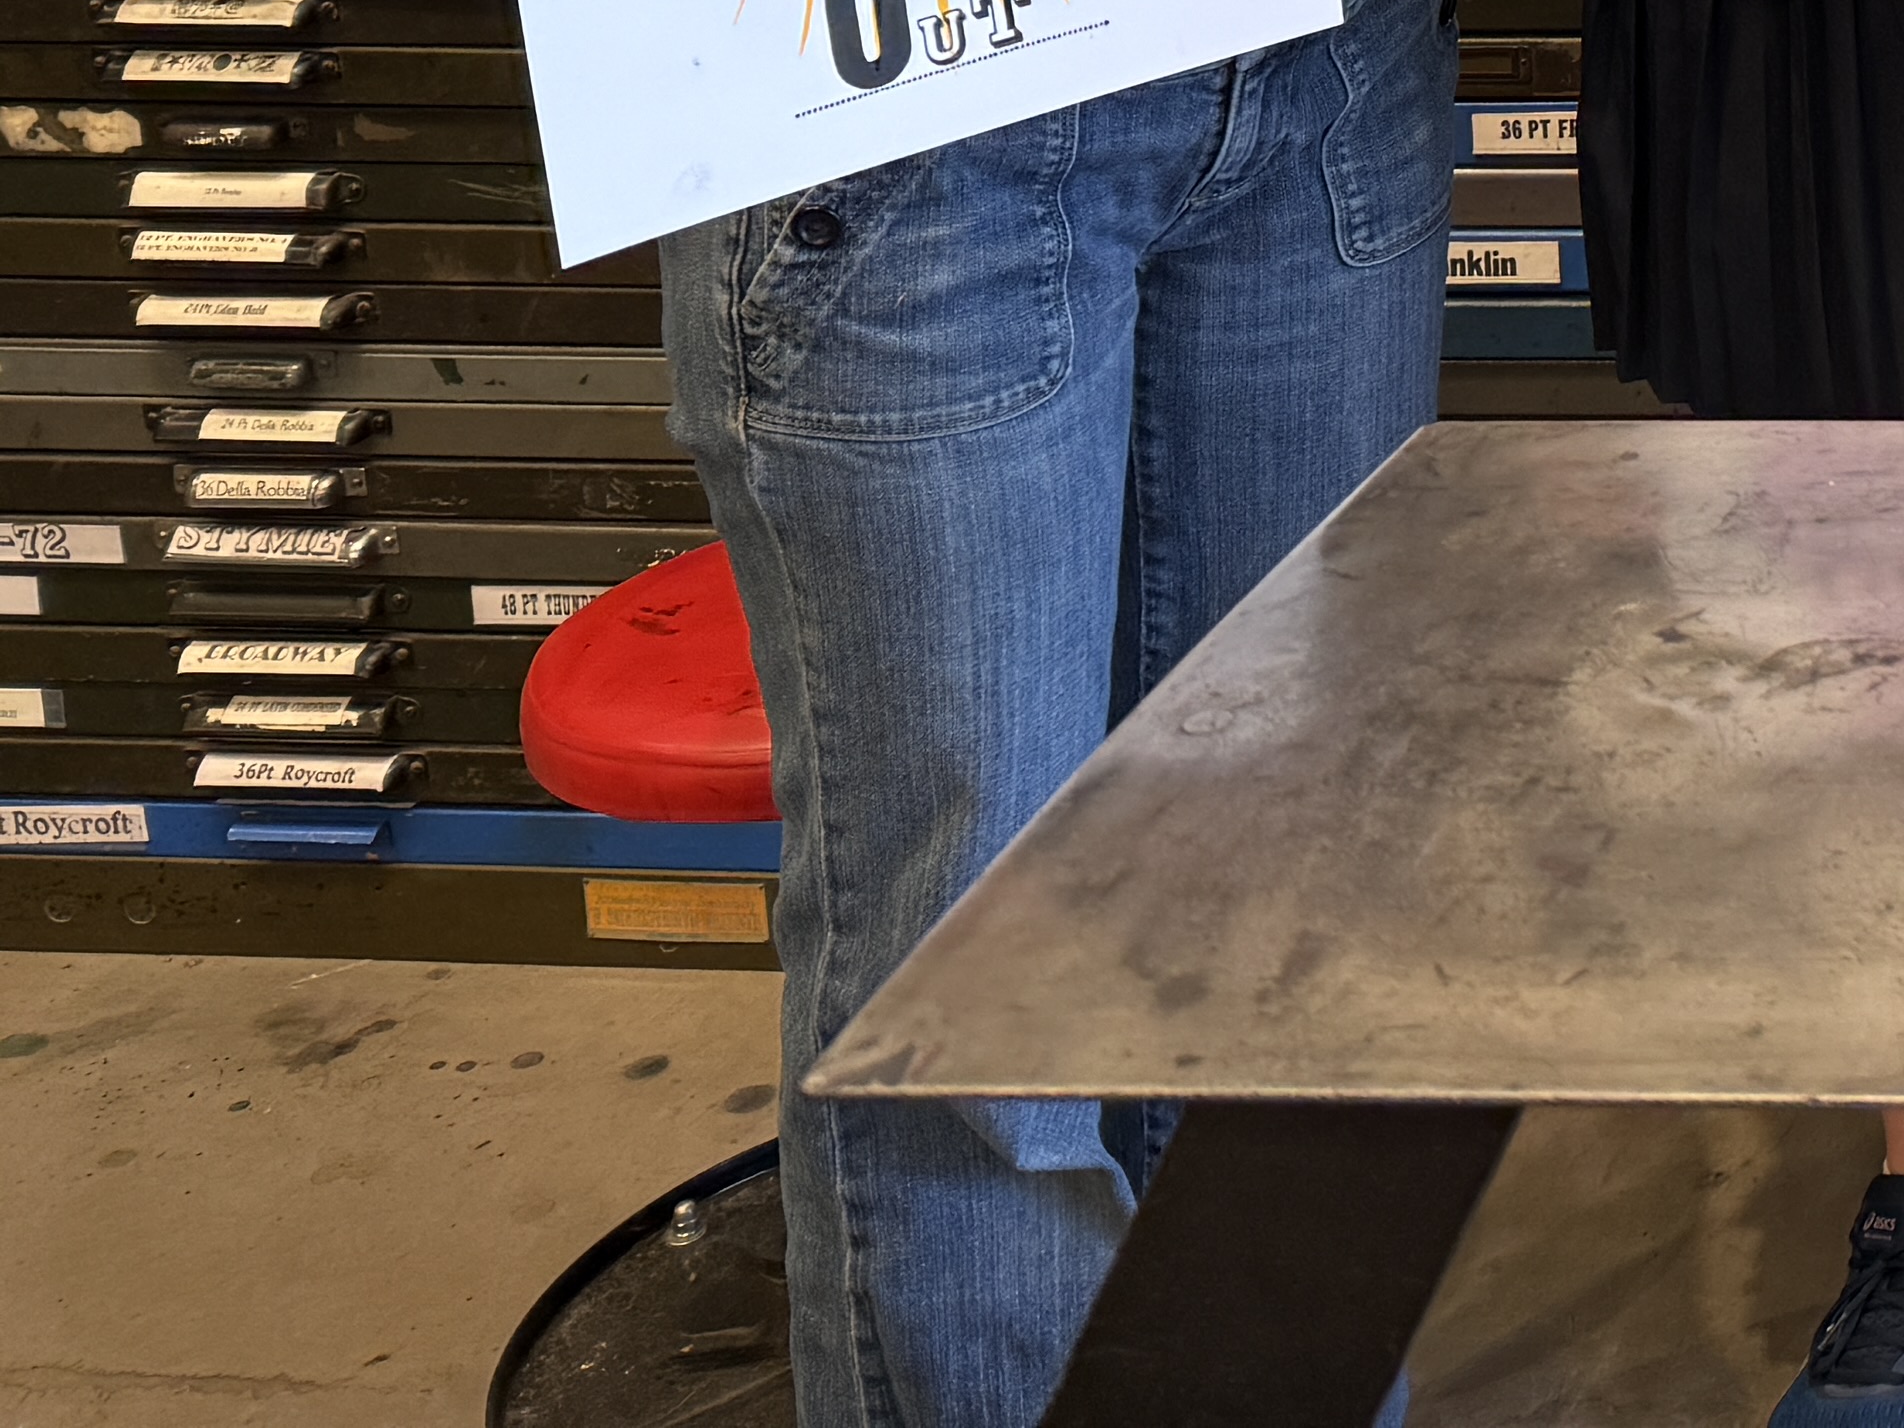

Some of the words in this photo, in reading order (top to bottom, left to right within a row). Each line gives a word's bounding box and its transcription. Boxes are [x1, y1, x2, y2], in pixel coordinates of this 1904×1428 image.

[1501, 120, 1522, 139] 36
[1528, 119, 1551, 138] PT
[502, 594, 517, 615] 48
[521, 594, 538, 615] PT
[234, 762, 274, 781] 36Pt
[281, 764, 356, 785] Roycroft
[15, 812, 133, 839] Roycroft
